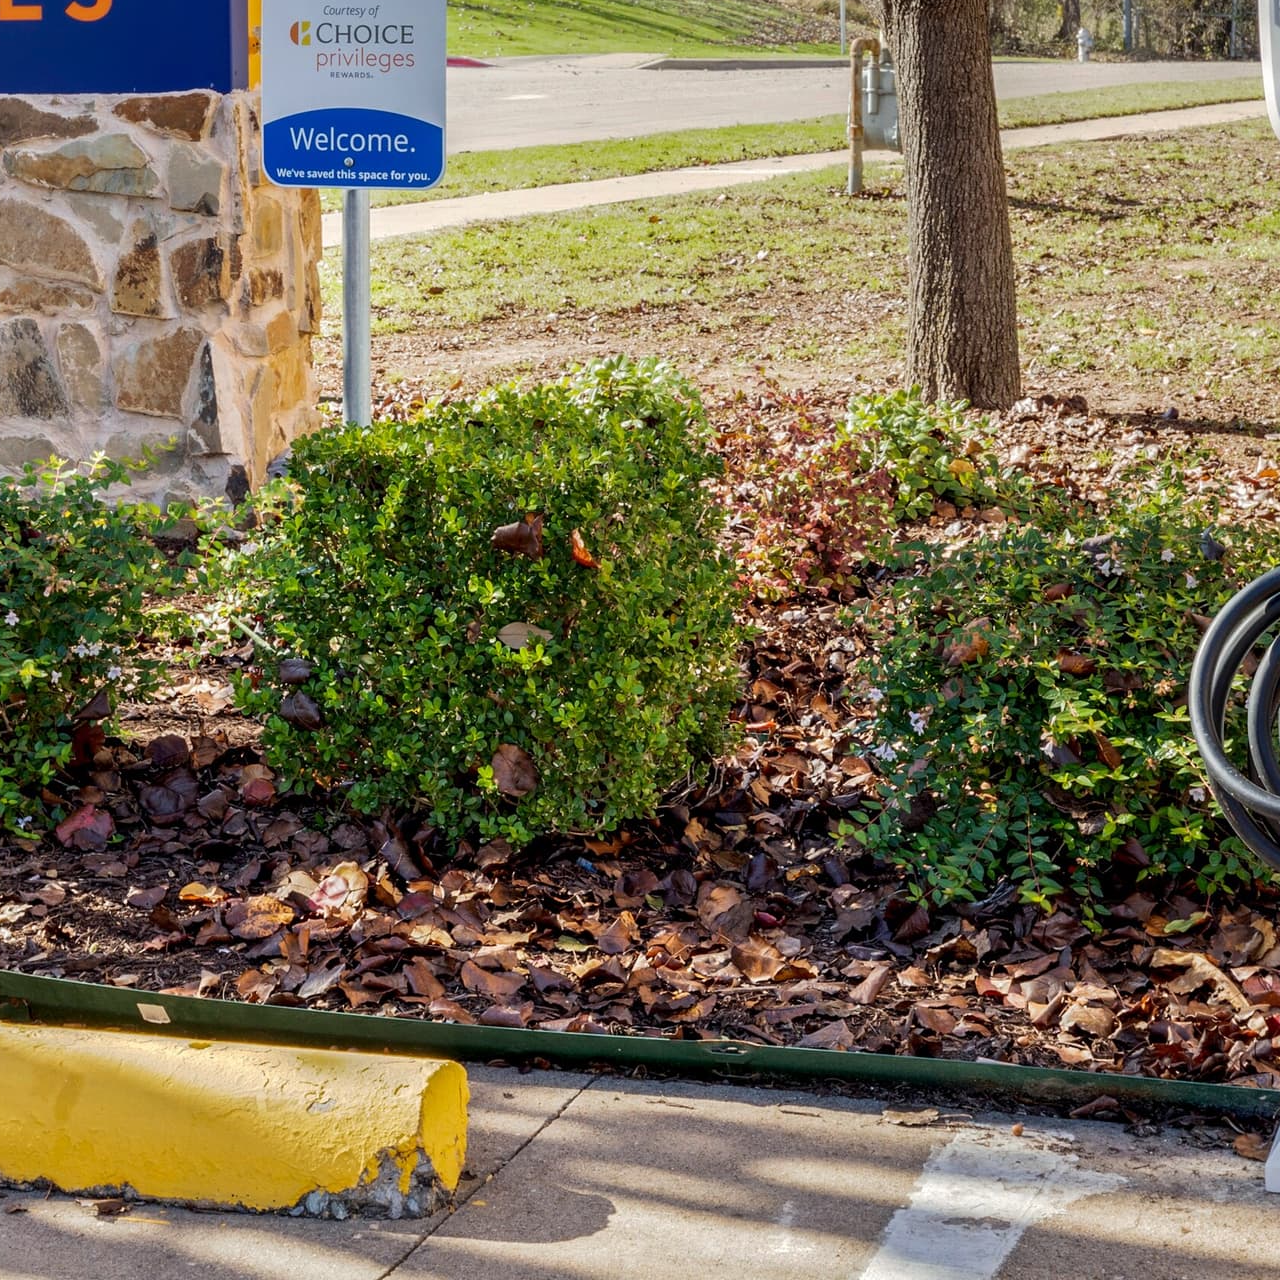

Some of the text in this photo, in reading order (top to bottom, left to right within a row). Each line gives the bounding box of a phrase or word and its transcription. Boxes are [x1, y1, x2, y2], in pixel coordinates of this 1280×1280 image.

[323, 4, 380, 18] Courtesy of
[315, 22, 415, 44] CHOICE
[316, 47, 415, 73] privileges
[289, 126, 416, 153] Welcome.
[276, 168, 431, 183] We've saved this space for you.
